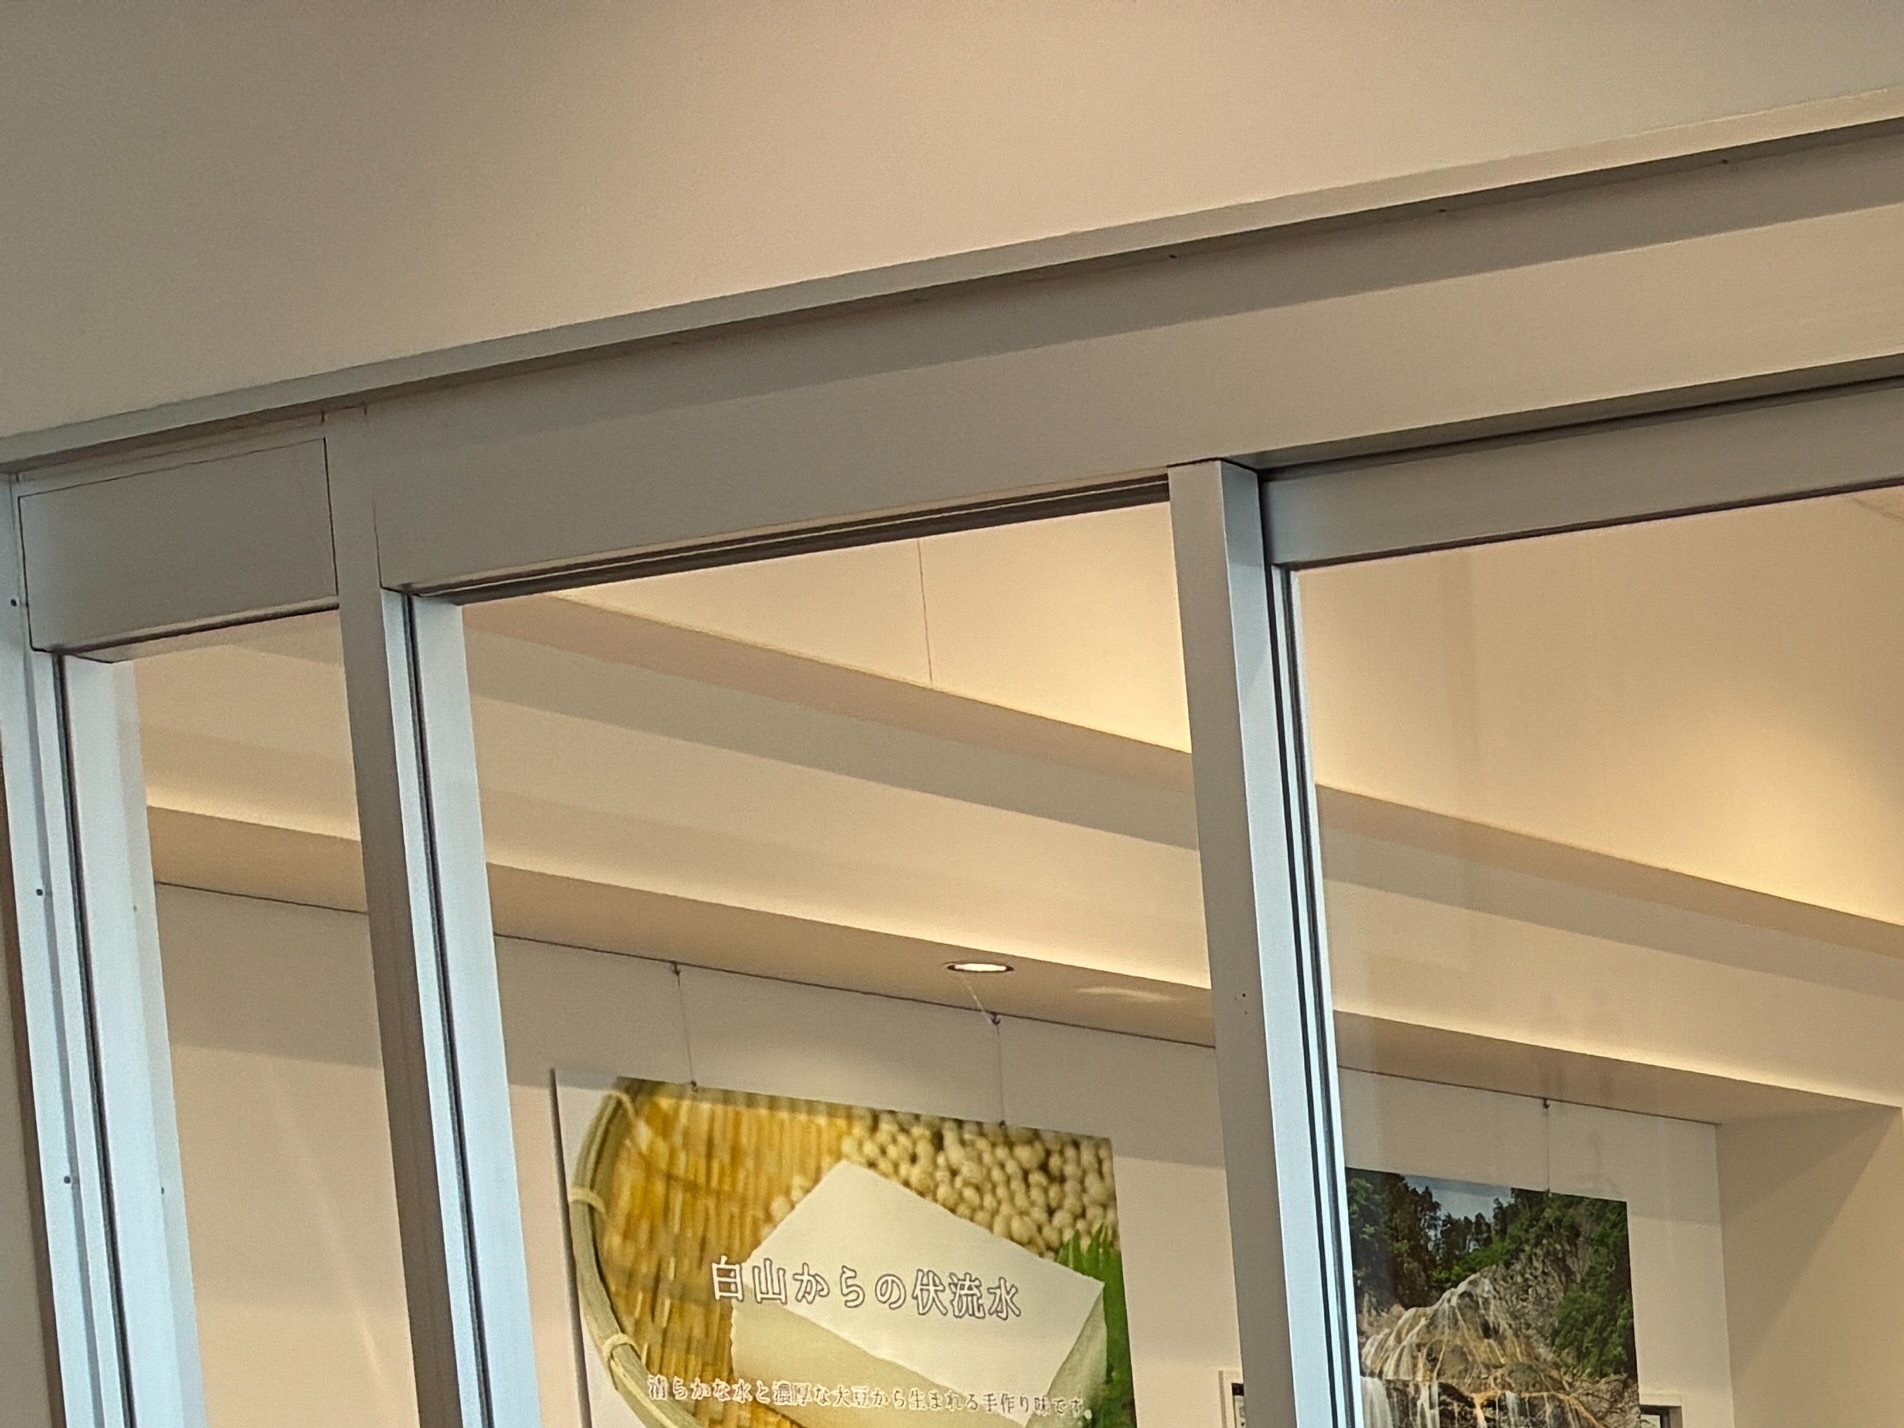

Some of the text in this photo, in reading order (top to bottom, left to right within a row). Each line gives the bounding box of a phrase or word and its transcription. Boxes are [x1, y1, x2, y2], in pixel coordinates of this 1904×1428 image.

[712, 1256, 1021, 1319] 白山からの伏流水
